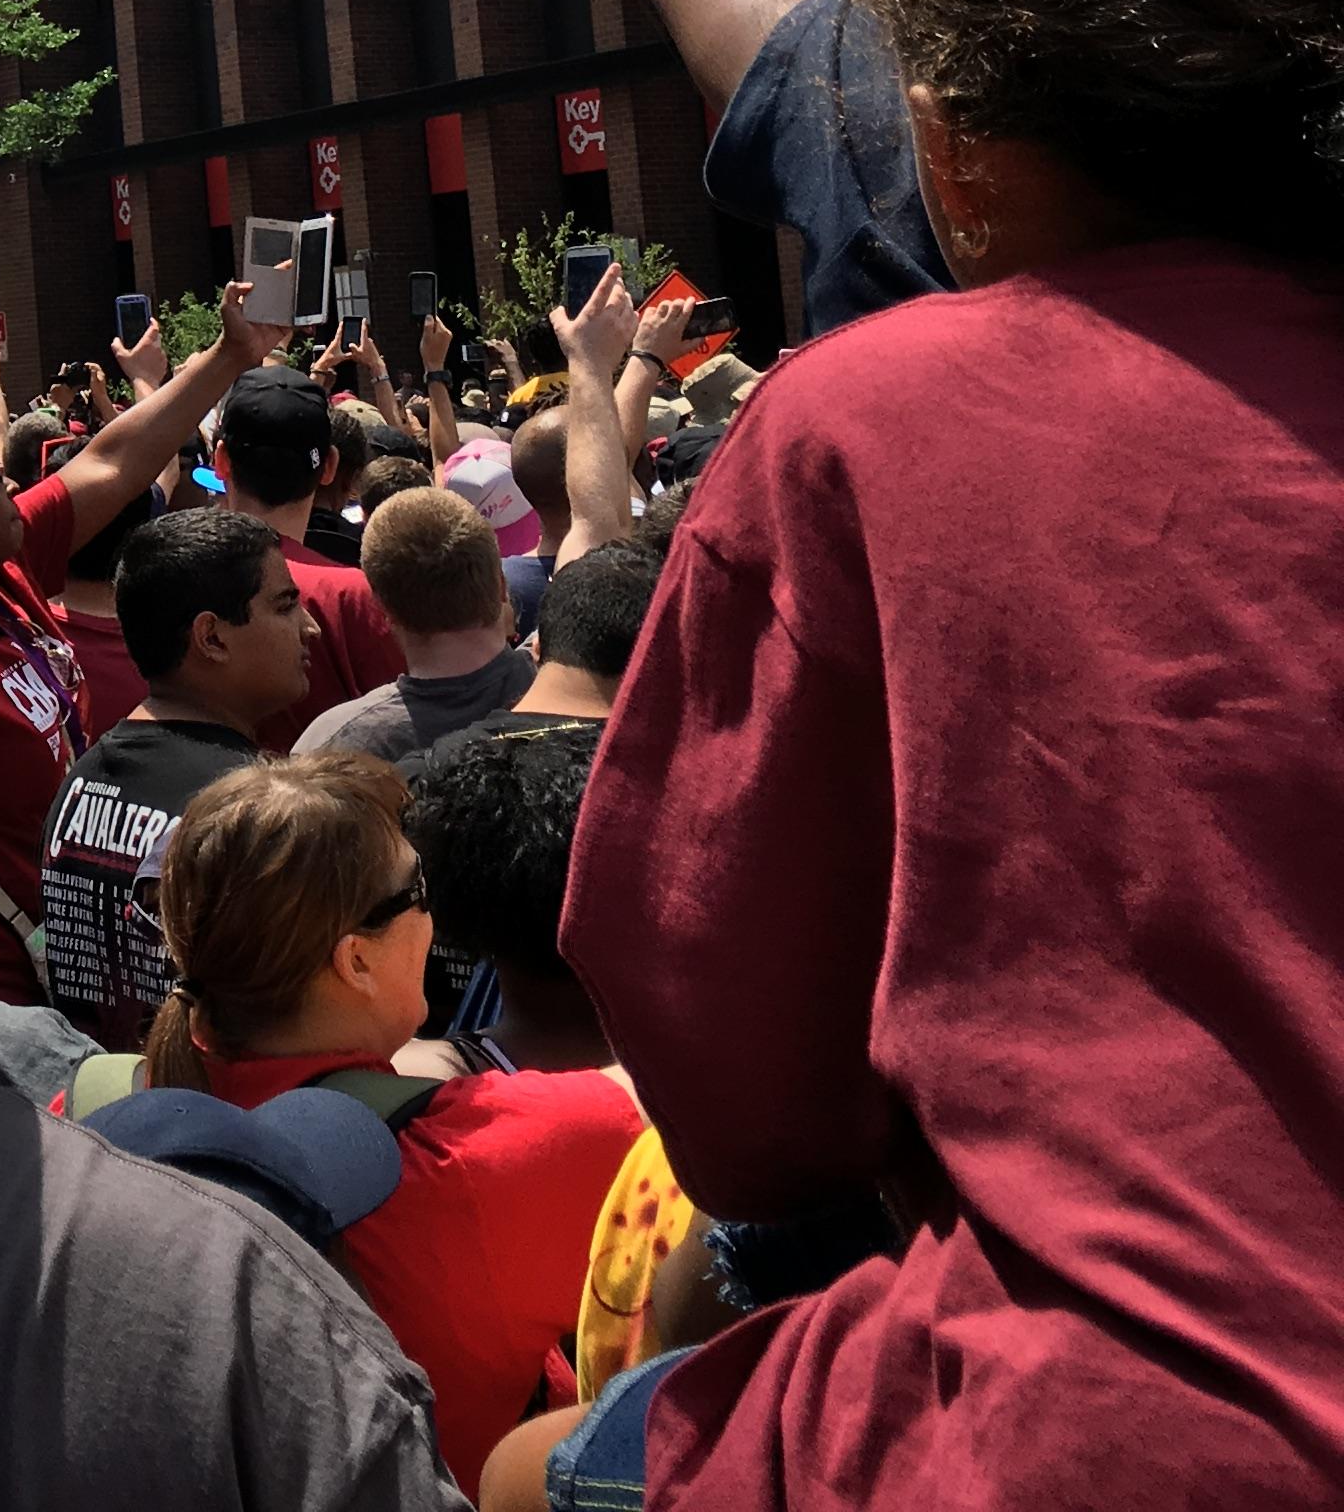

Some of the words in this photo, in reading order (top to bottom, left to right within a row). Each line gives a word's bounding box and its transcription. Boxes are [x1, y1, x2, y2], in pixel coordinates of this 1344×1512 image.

[564, 97, 600, 124] Key
[316, 142, 338, 164] Ke
[50, 776, 182, 858] CAVALIER
